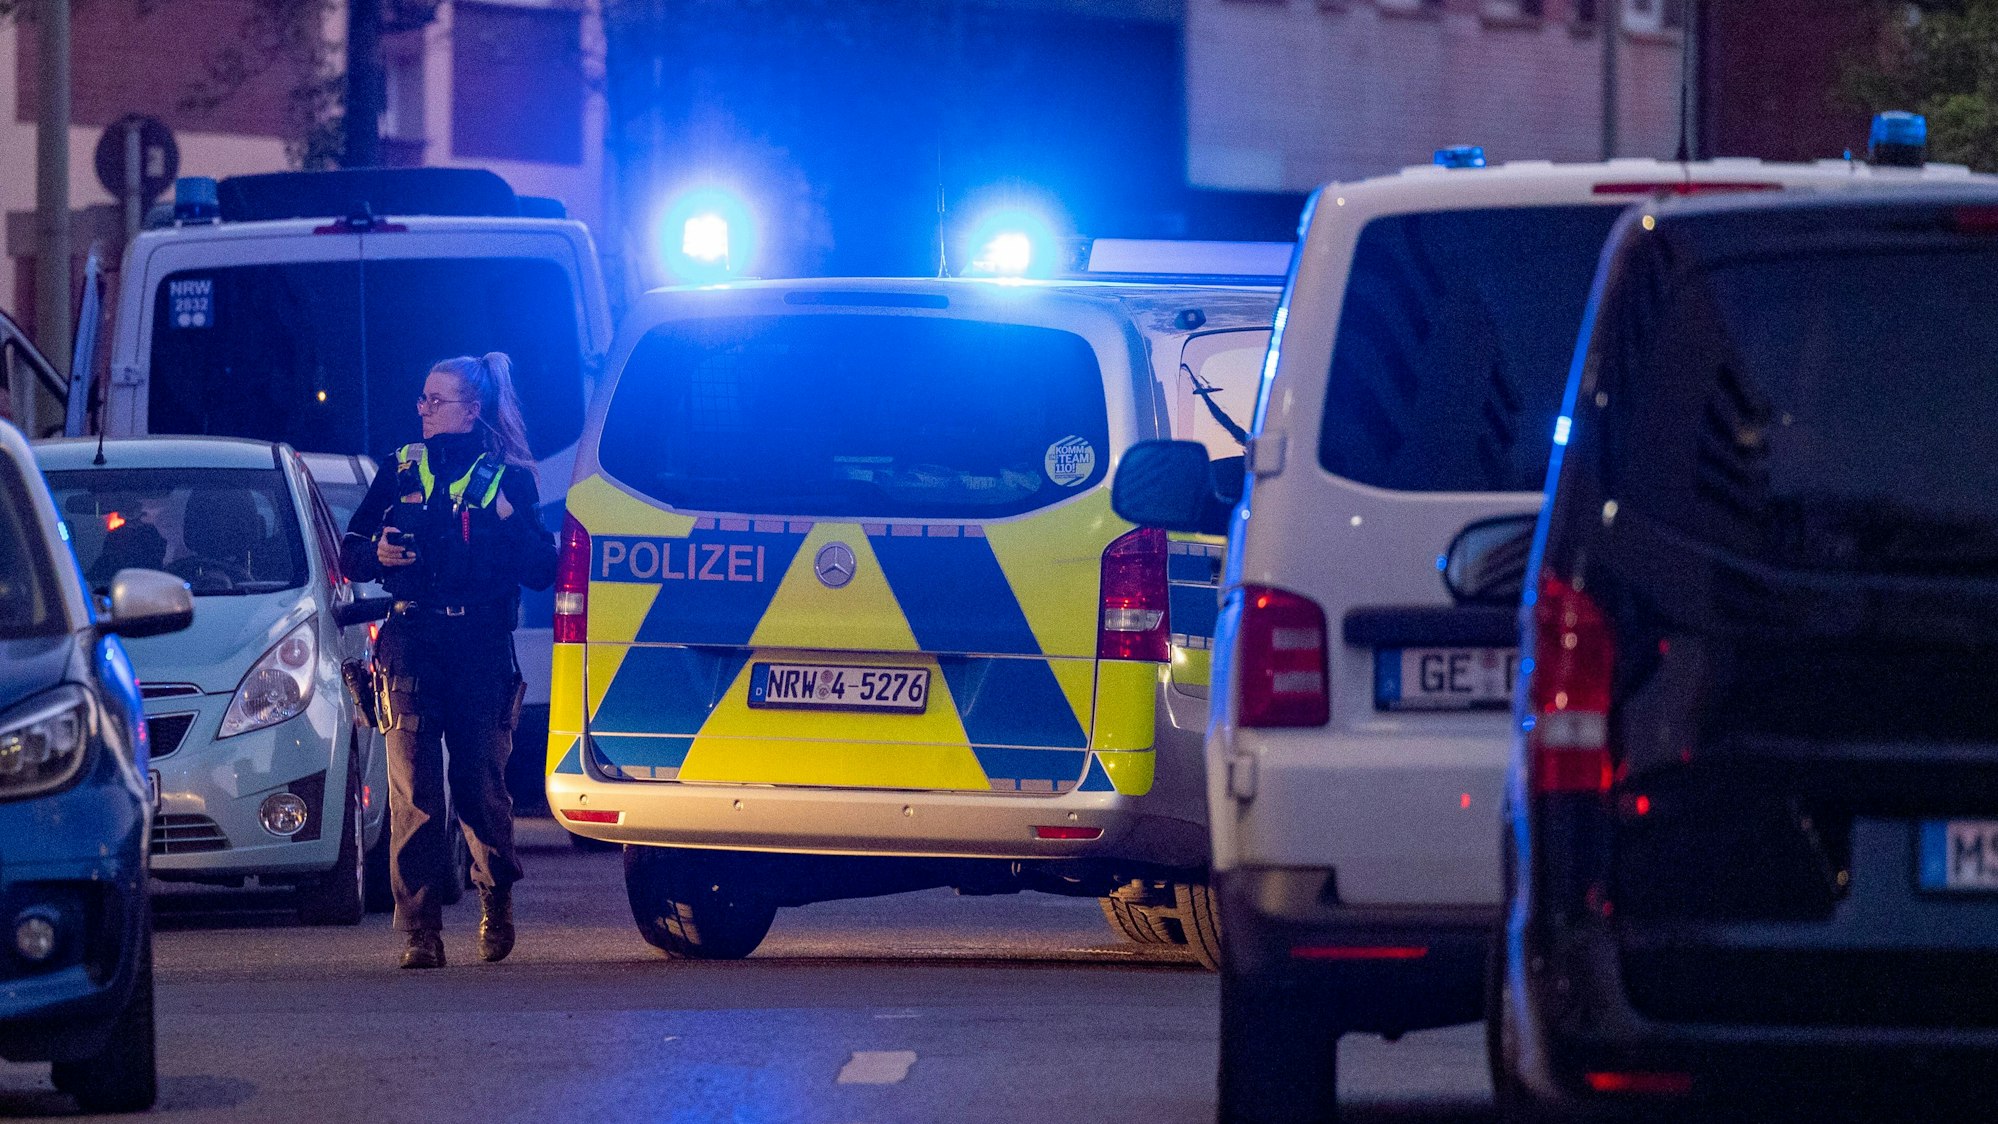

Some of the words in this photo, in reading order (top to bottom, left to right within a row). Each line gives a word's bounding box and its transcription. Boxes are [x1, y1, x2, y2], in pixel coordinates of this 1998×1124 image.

[170, 280, 212, 296] NRW
[1055, 445, 1085, 455] KOMM
[1059, 453, 1090, 464] TEAM
[1055, 463, 1076, 473] 110!
[602, 541, 765, 582] POLIZEI
[1420, 654, 1473, 692] GE
[767, 670, 818, 699] NRW
[831, 671, 924, 702] 4-5276
